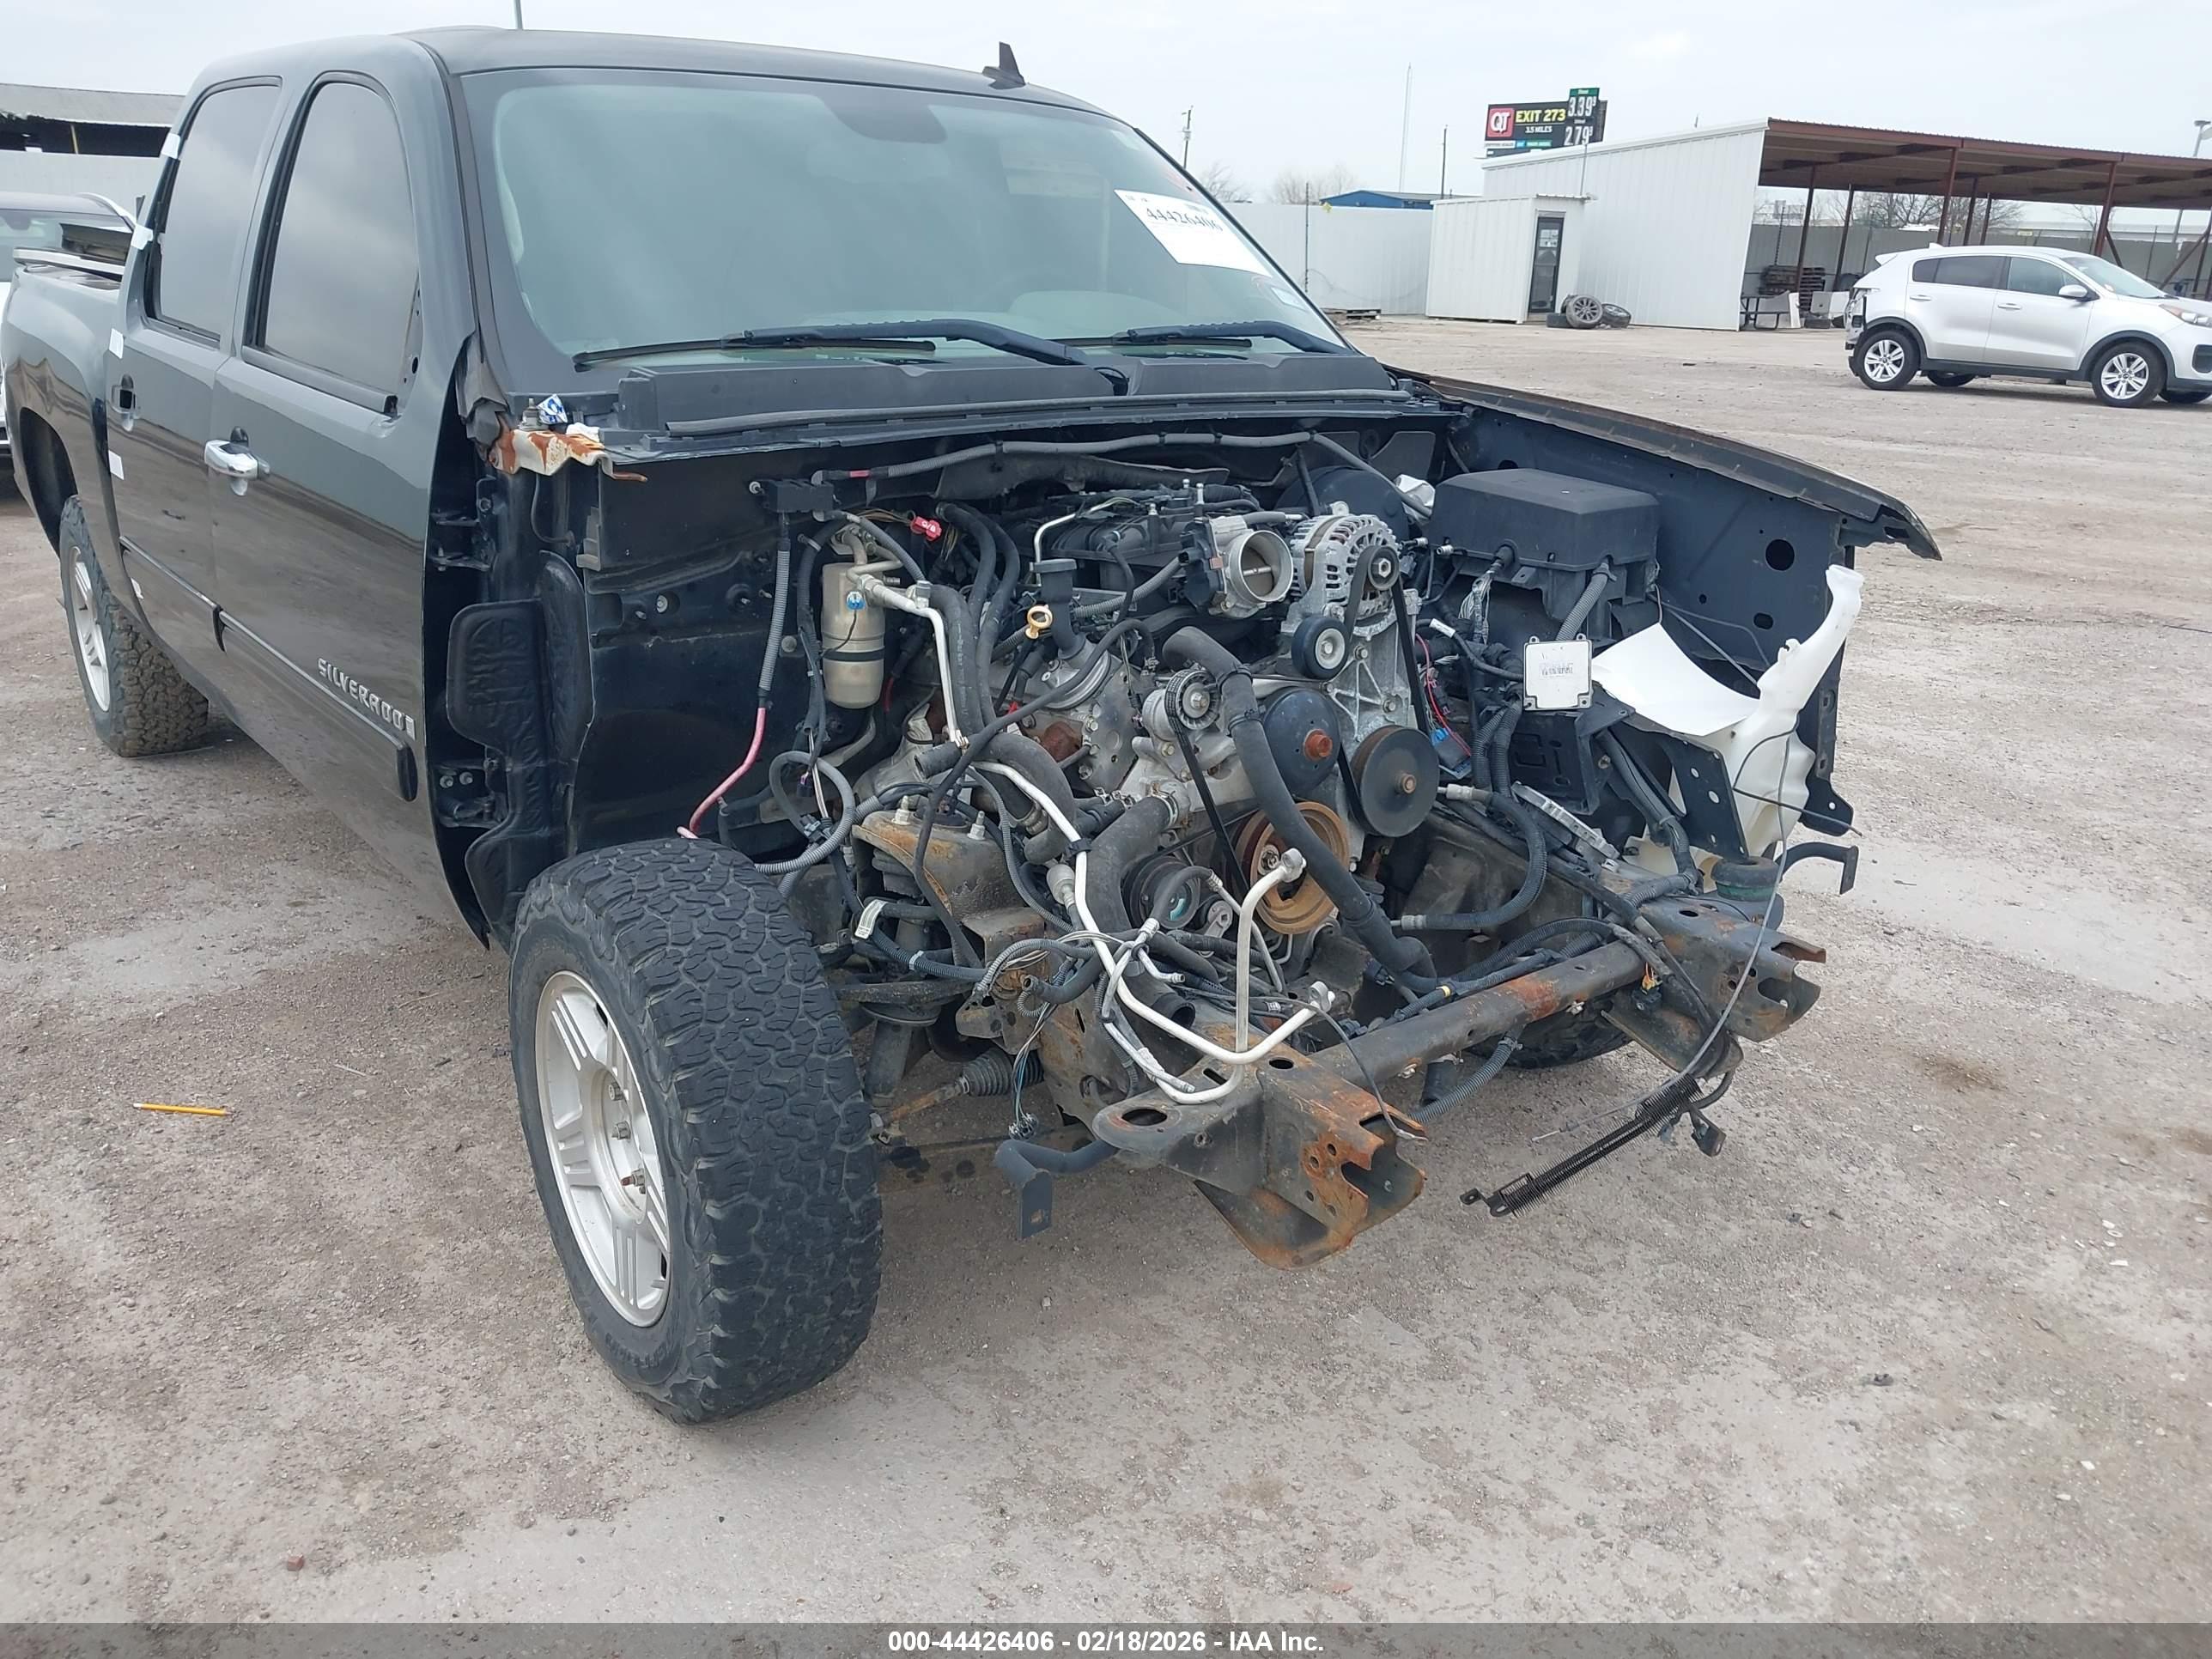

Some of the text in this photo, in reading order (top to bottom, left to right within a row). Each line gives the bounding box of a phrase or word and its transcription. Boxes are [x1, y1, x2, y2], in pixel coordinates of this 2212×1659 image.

[1491, 112, 1510, 133] QT
[1516, 110, 1541, 122] EXIT
[1543, 109, 1565, 122] 273
[317, 658, 405, 732] SILVERADO
